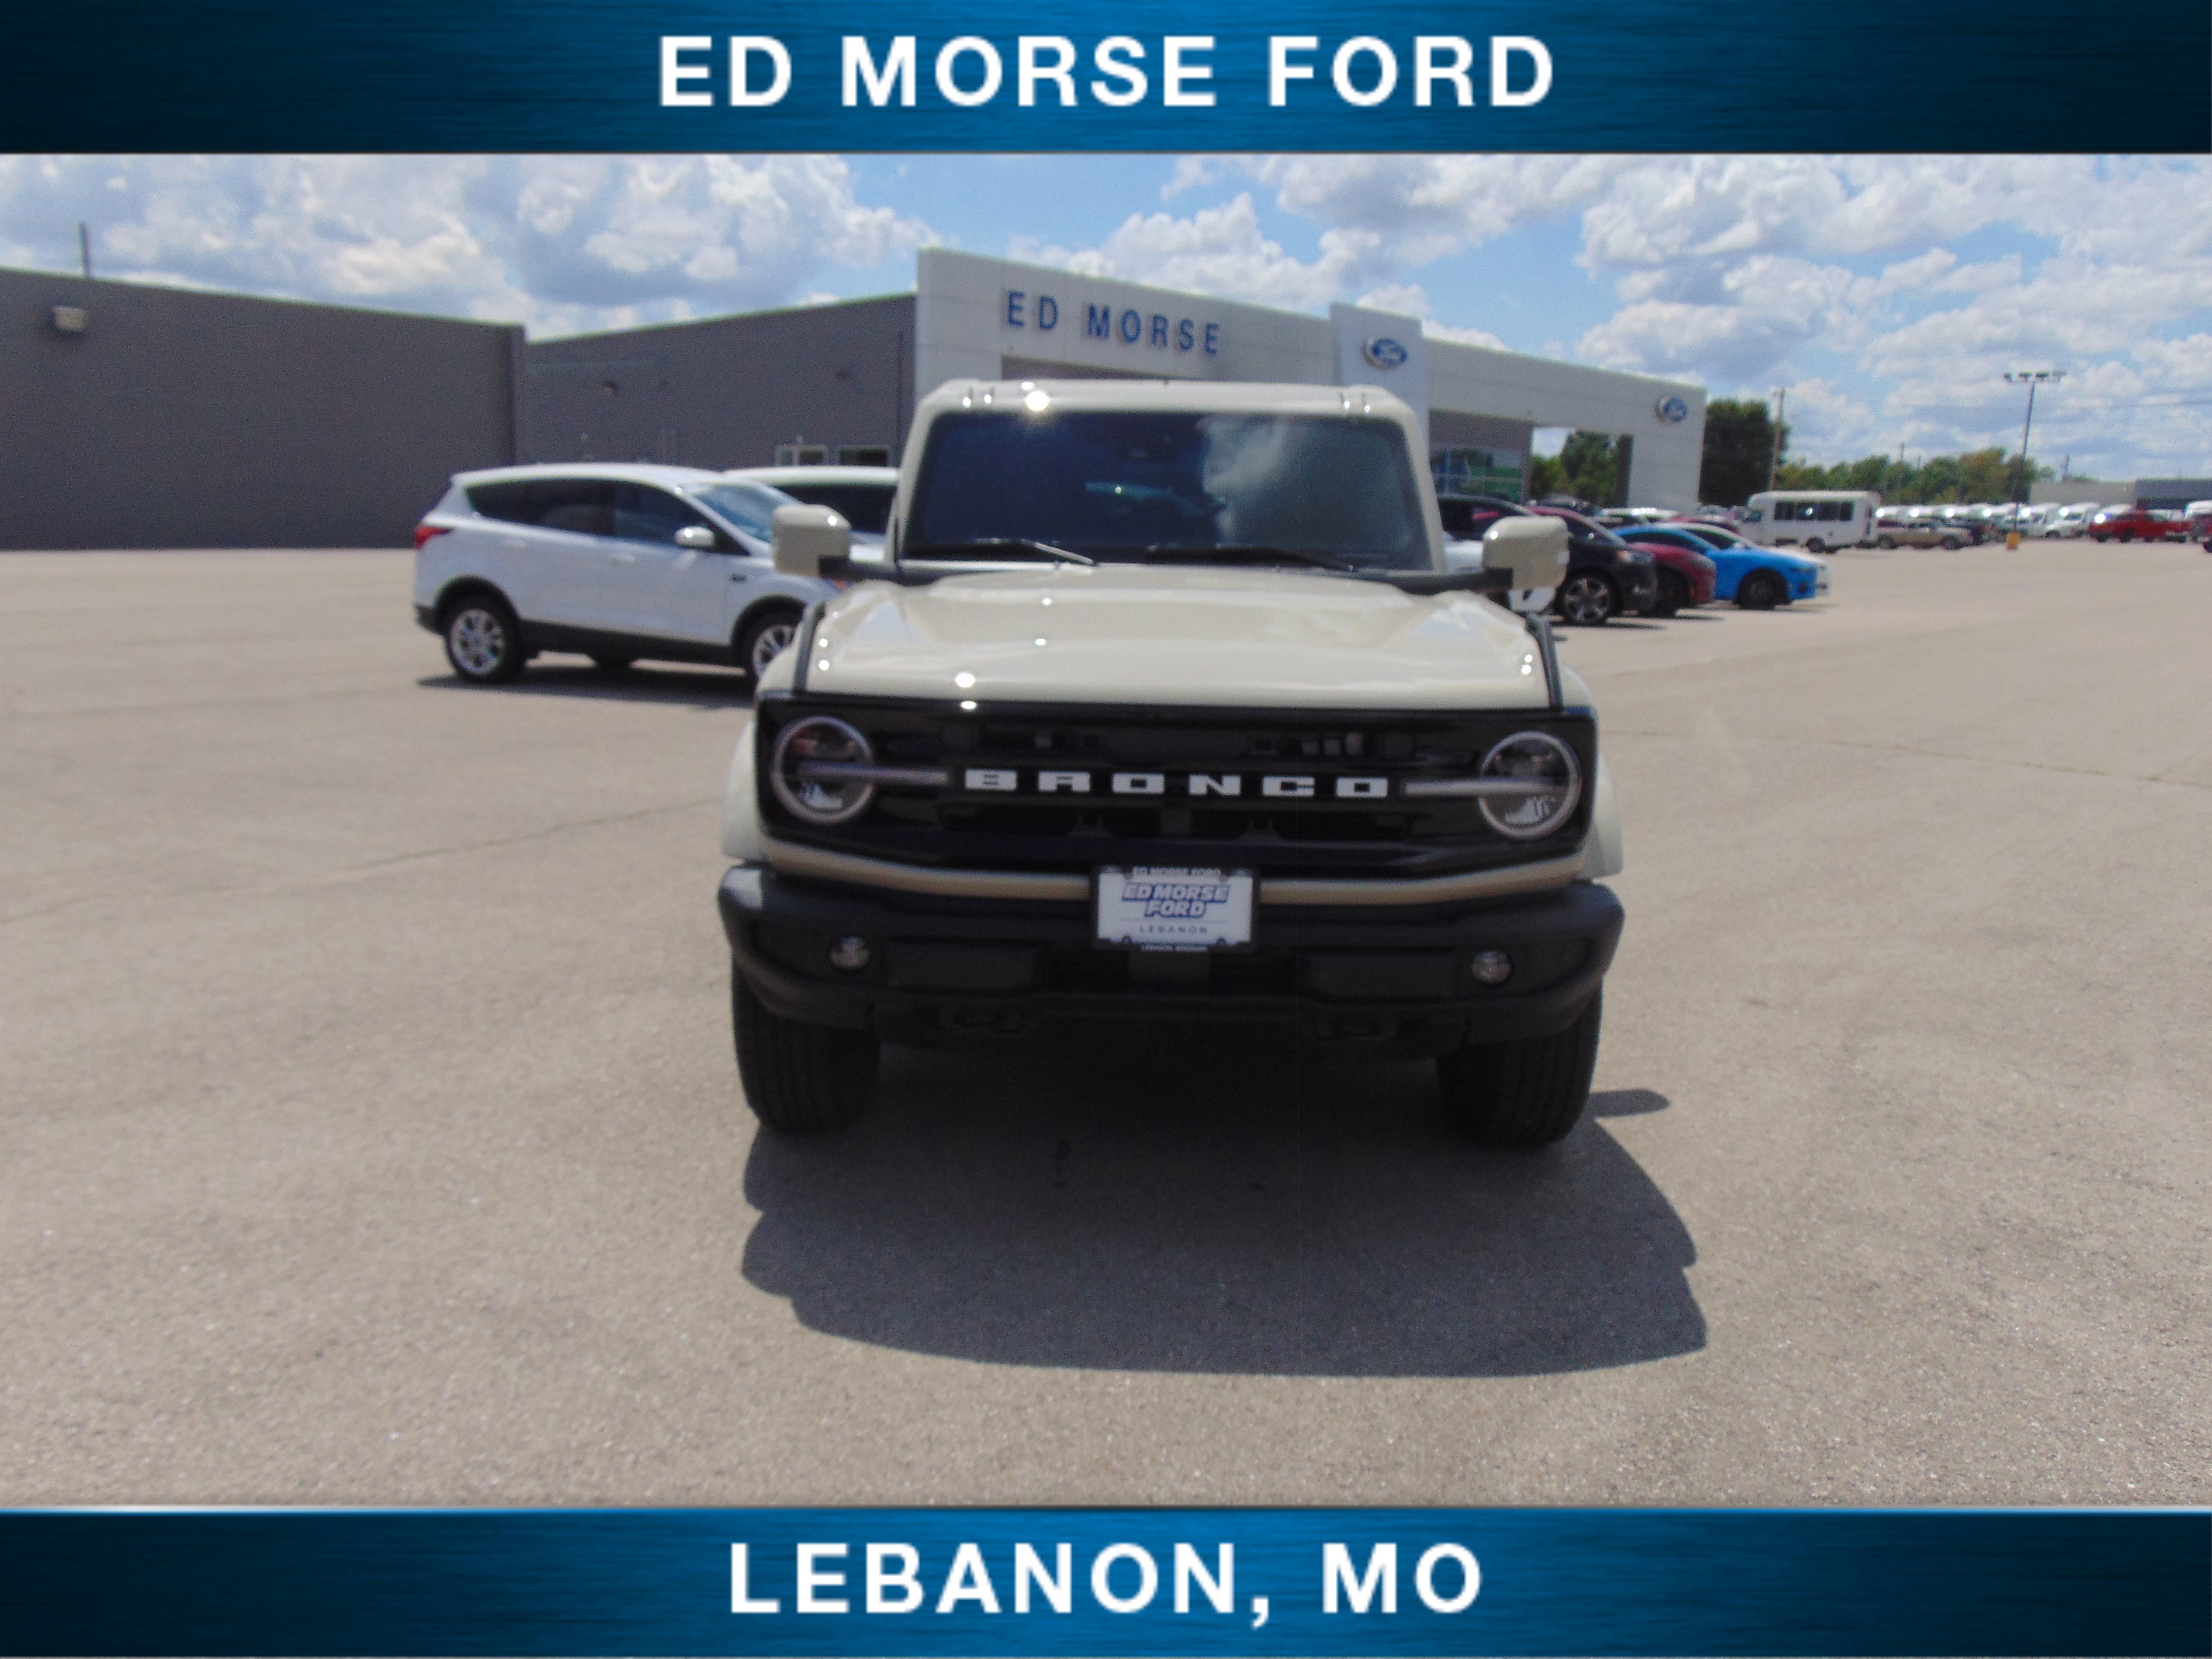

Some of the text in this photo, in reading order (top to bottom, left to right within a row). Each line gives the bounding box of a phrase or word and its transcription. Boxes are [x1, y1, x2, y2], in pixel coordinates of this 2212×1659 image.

[1008, 291, 1221, 353] ED MORSE
[964, 769, 1388, 798] BRONCO
[1122, 882, 1230, 902] ED MORSE
[1145, 900, 1206, 918] FORD
[1139, 925, 1207, 934] LEBANON
